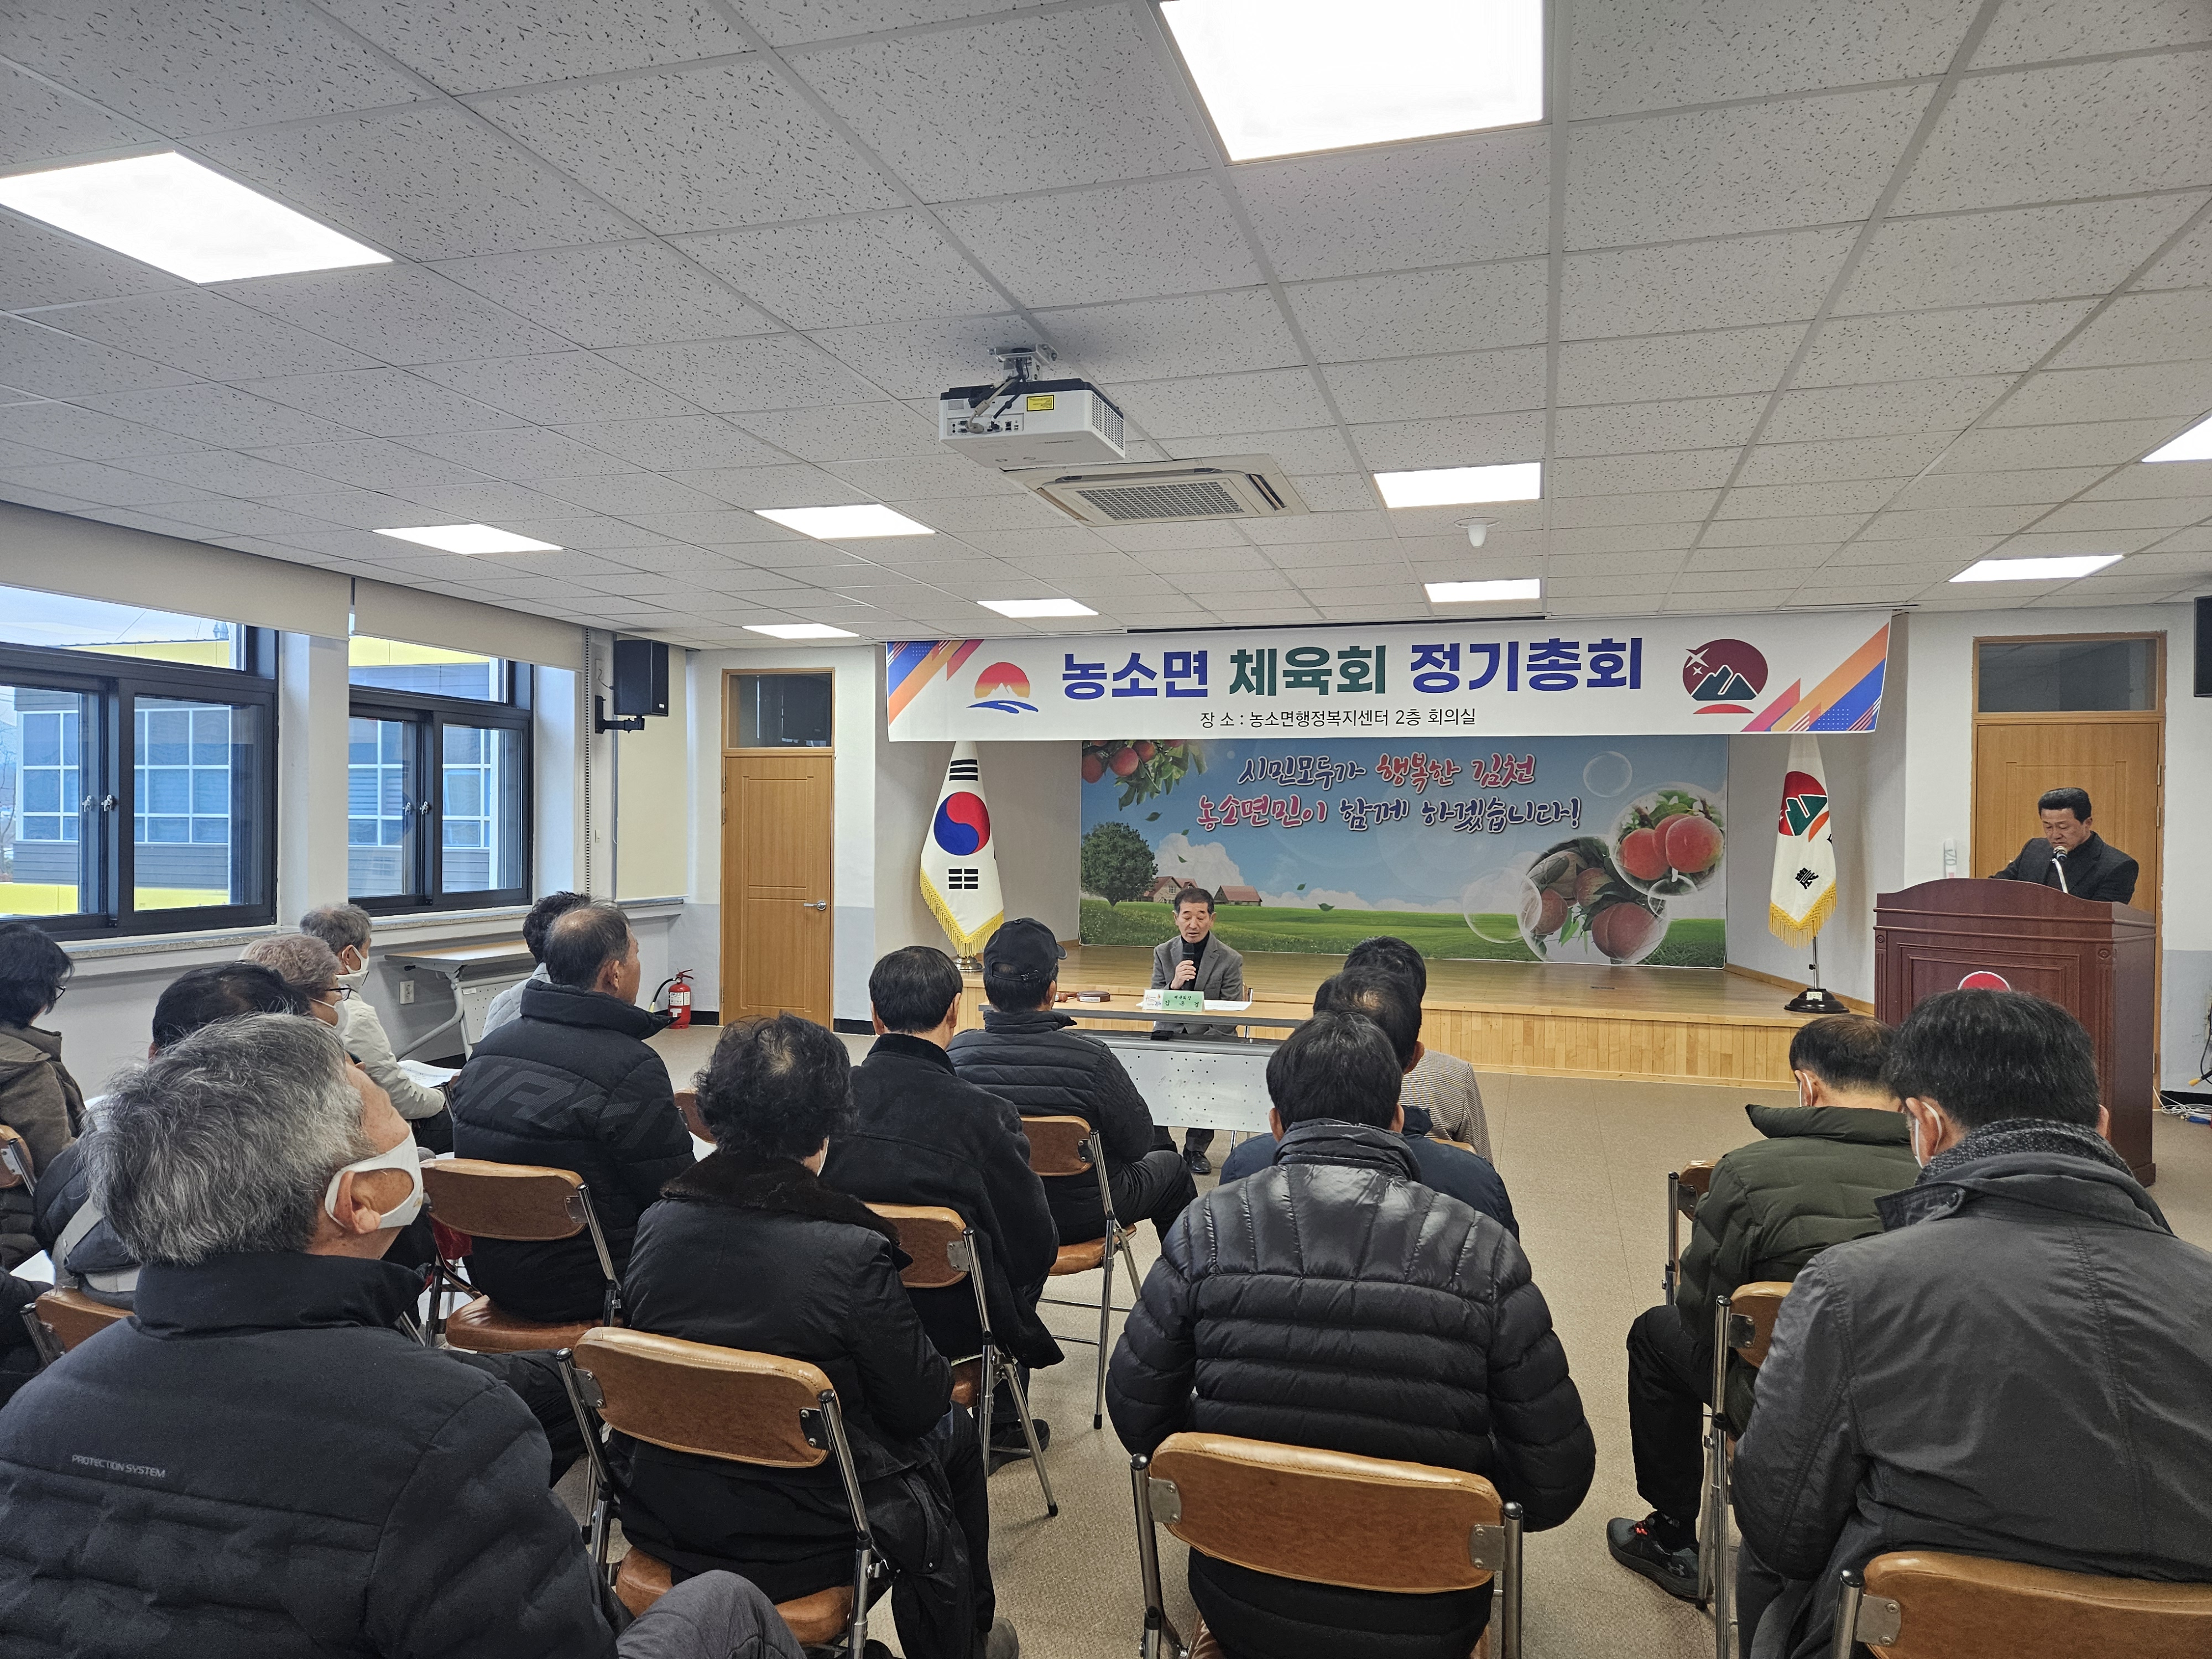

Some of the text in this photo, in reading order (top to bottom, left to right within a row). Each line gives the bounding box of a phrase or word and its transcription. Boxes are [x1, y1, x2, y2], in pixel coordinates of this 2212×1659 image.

[1062, 637, 1642, 700] 농소면 체육회 정기총회
[1249, 709, 1388, 728] 농소면행정복지센터
[1395, 708, 1421, 726] 2층
[1427, 708, 1475, 726] 회의실
[1238, 752, 1535, 794] 시민모두가 행복한 김천
[1197, 794, 1580, 833] 농소면민이 함께 하겠습니다!
[1795, 867, 1819, 889] 農
[71, 1454, 165, 1478] PROTECTION SYSTEM
